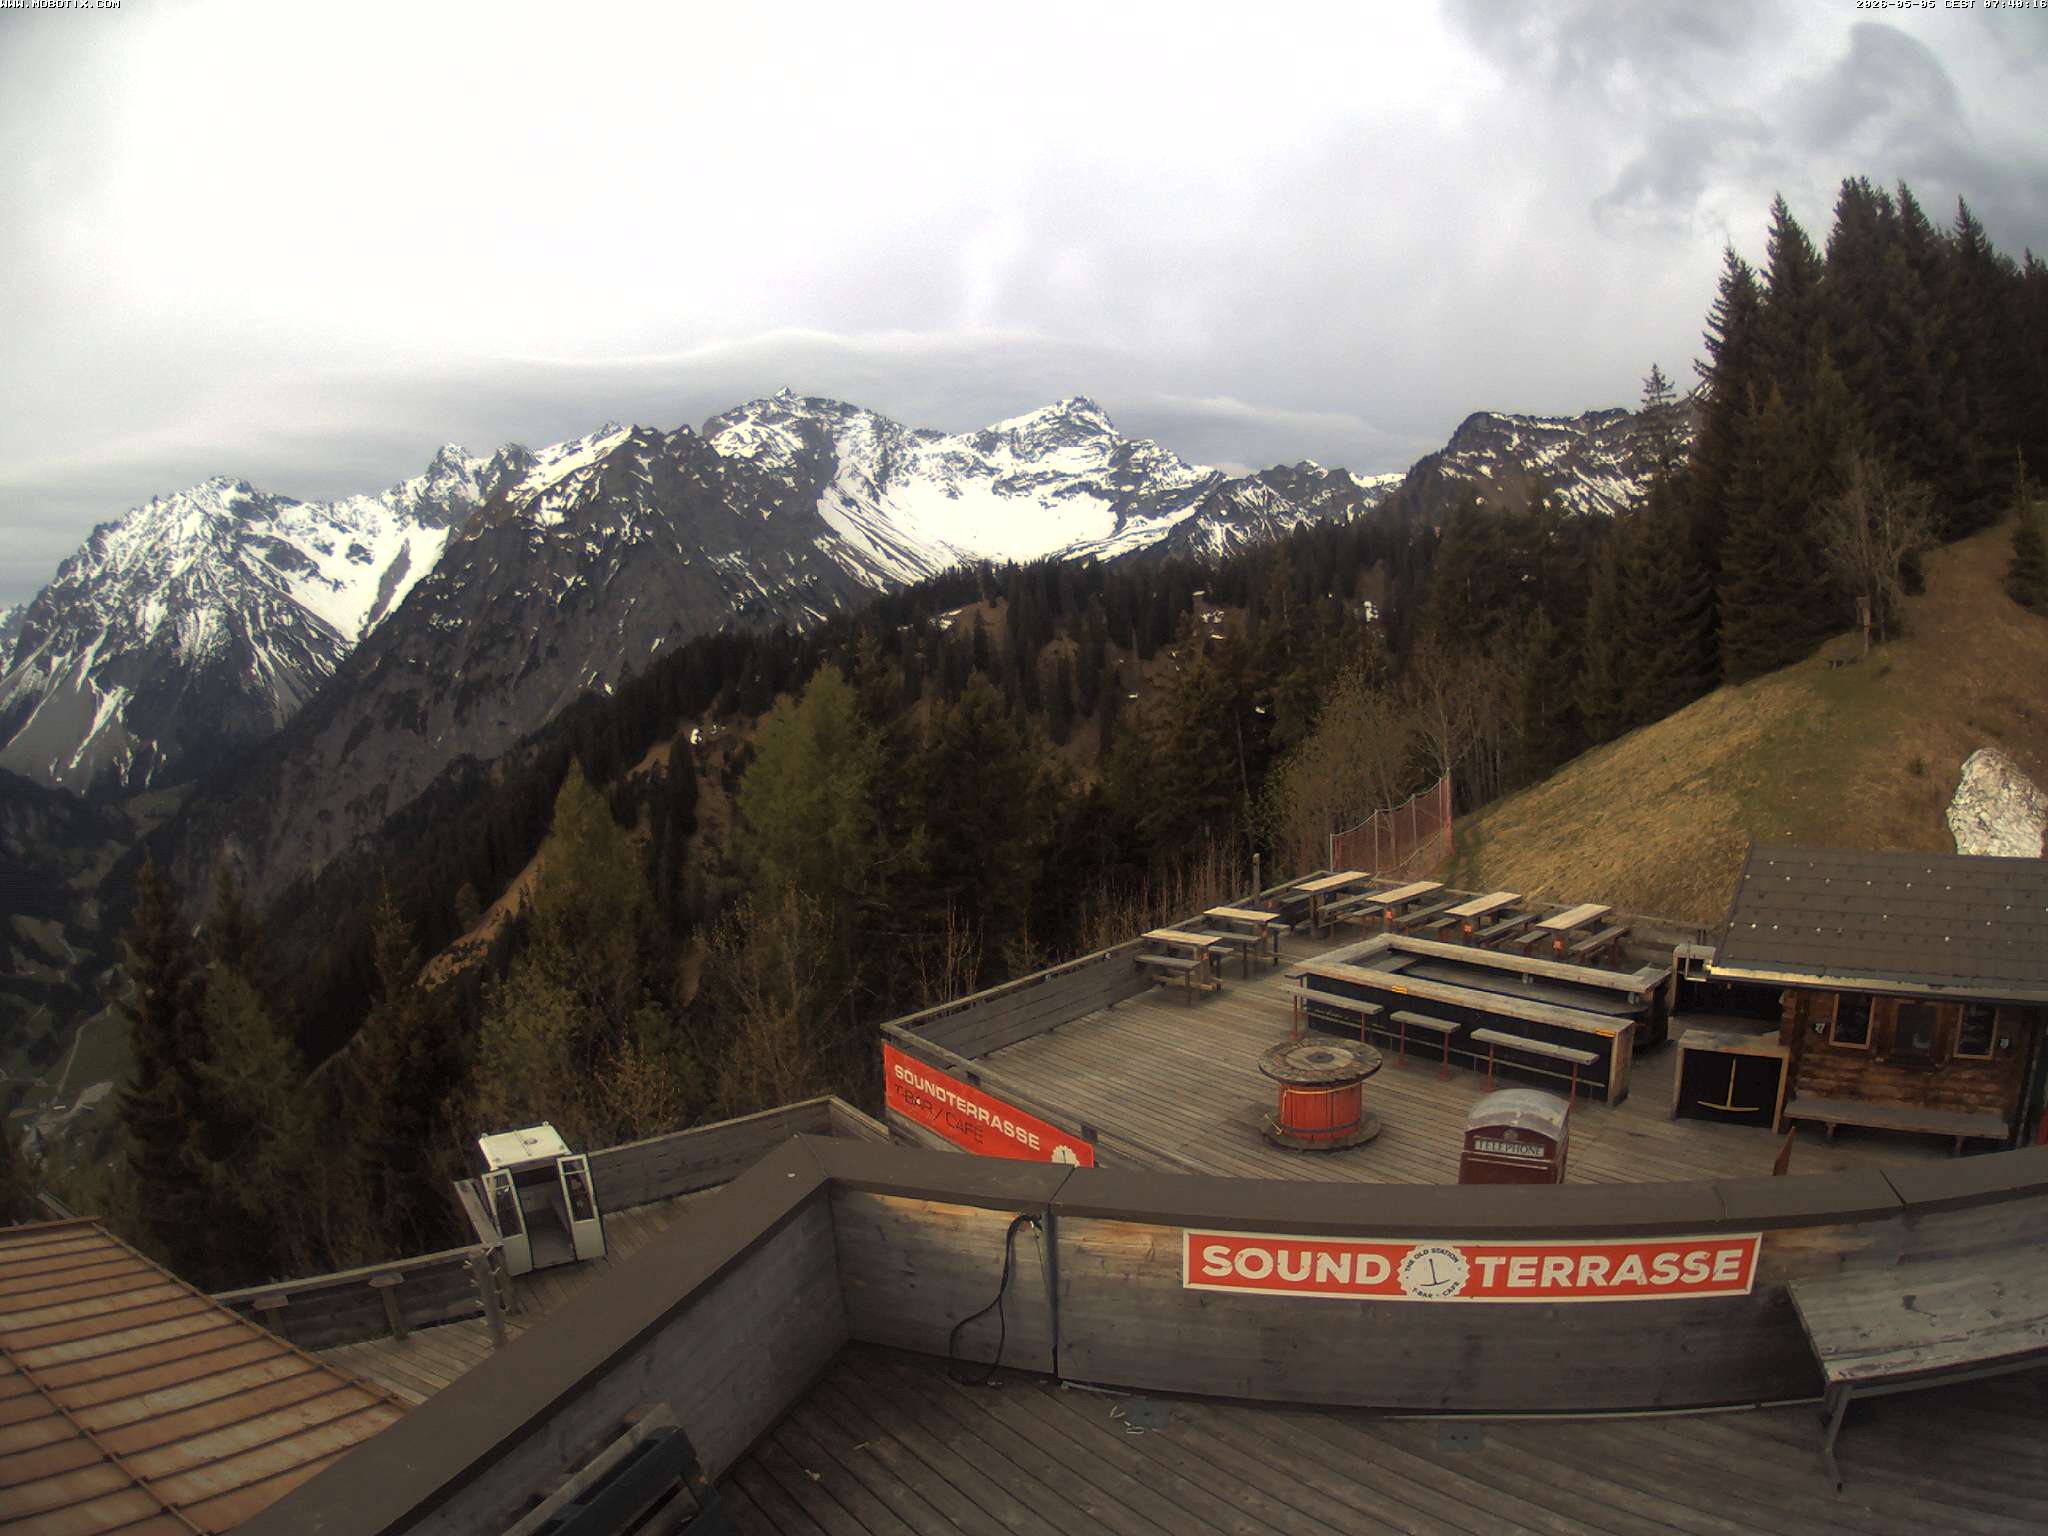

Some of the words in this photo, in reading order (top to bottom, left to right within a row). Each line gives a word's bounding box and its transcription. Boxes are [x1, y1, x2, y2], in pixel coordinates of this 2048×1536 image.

[894, 1063, 1041, 1152] SOUNDTERRASSE
[1474, 1139, 1542, 1156] TELEPHONE
[1201, 1244, 1391, 1286] SOUND
[1404, 1259, 1415, 1272] THE
[1414, 1248, 1429, 1260] OLD
[1431, 1247, 1460, 1264] STATION
[1475, 1248, 1744, 1288] TERRASSE
